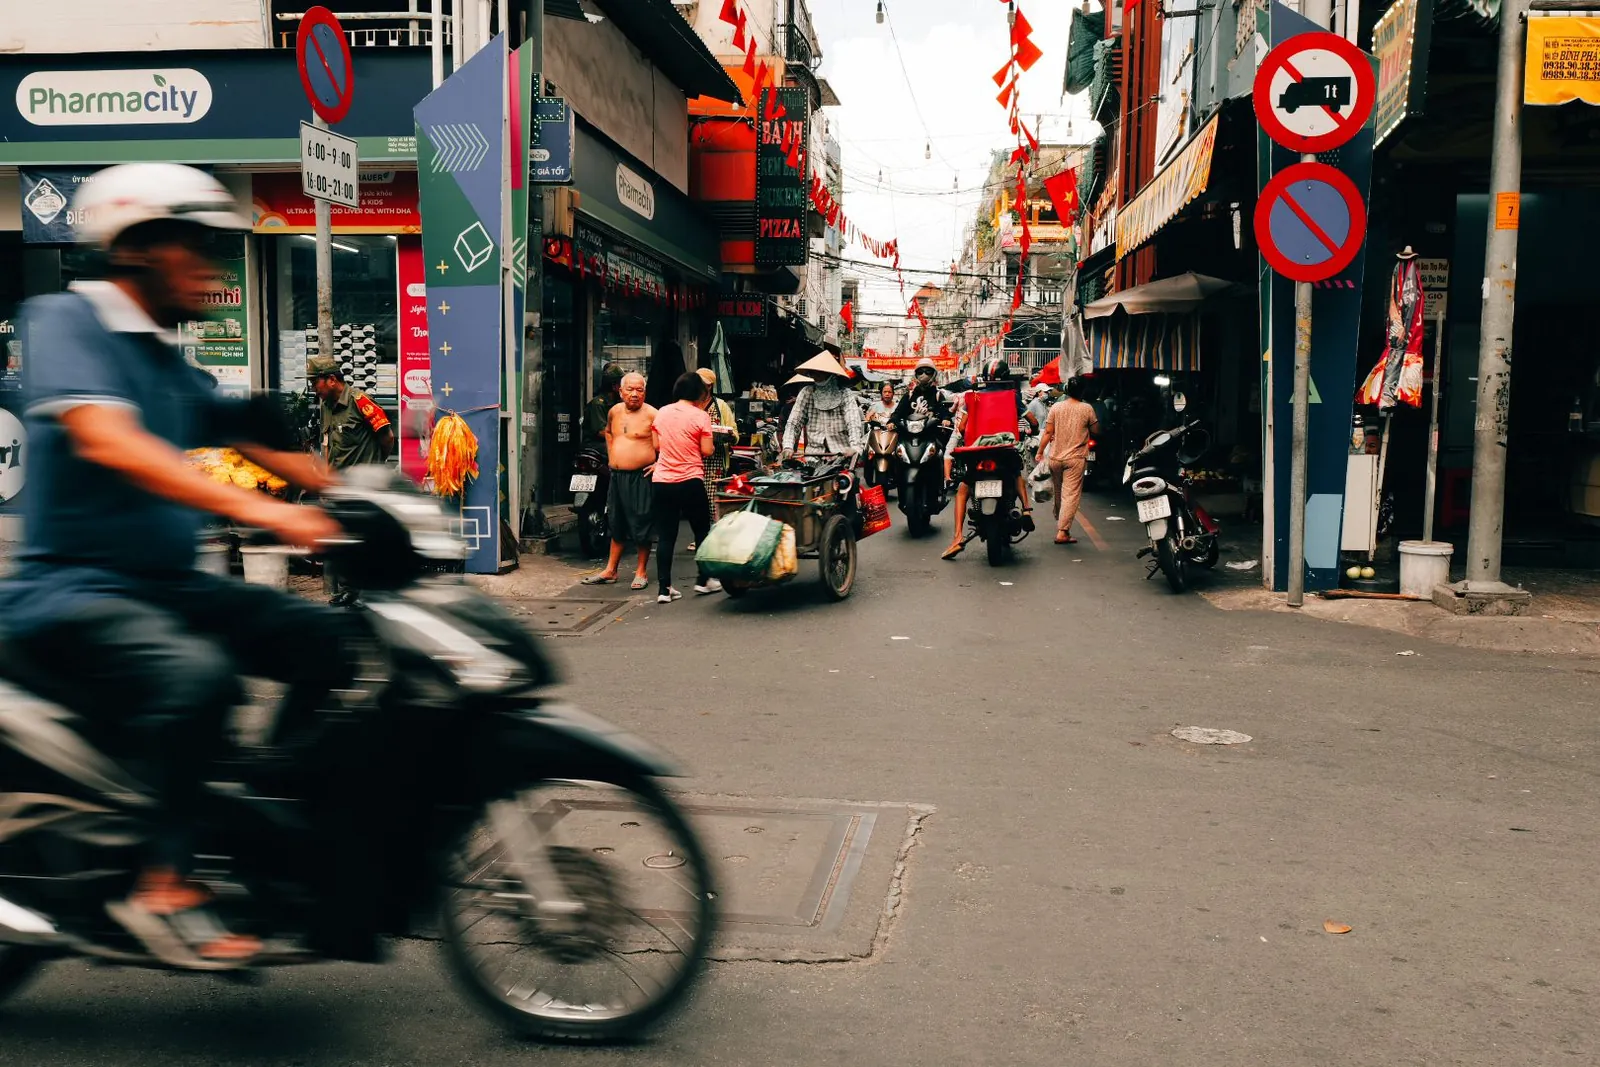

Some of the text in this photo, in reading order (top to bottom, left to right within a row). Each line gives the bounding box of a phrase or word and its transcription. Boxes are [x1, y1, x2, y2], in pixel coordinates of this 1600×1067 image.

[29, 82, 198, 118] Pharmacity
[1323, 84, 1338, 99] 1t
[537, 167, 550, 175] GIÁ
[551, 165, 565, 175] TỐT
[618, 174, 653, 216] Pharmacity
[1508, 206, 1513, 216] 7
[759, 217, 801, 238] PIZZA
